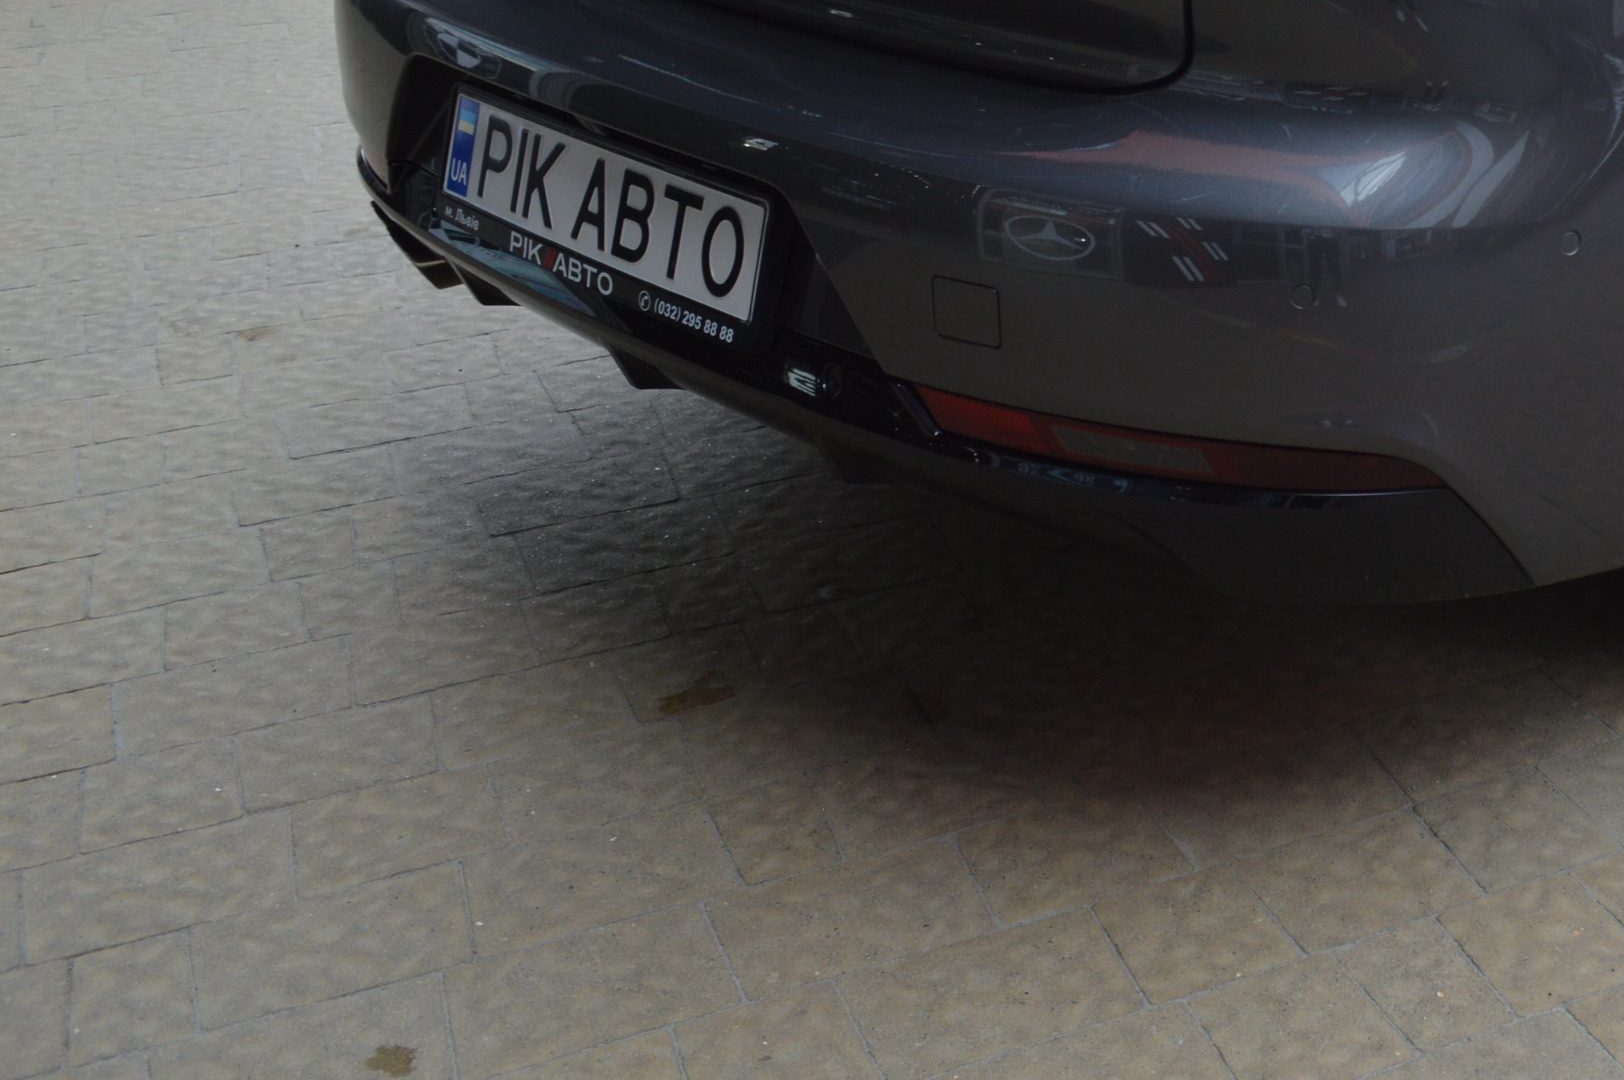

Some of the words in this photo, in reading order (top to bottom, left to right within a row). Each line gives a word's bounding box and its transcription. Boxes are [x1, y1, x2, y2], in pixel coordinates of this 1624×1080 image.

[451, 160, 467, 187] UA
[454, 207, 480, 231] Львів
[477, 113, 567, 230] РІК
[570, 157, 745, 298] АВТО
[653, 297, 681, 322] (032)
[681, 310, 703, 330] 295
[703, 319, 718, 337] 88
[718, 325, 734, 343] 88
